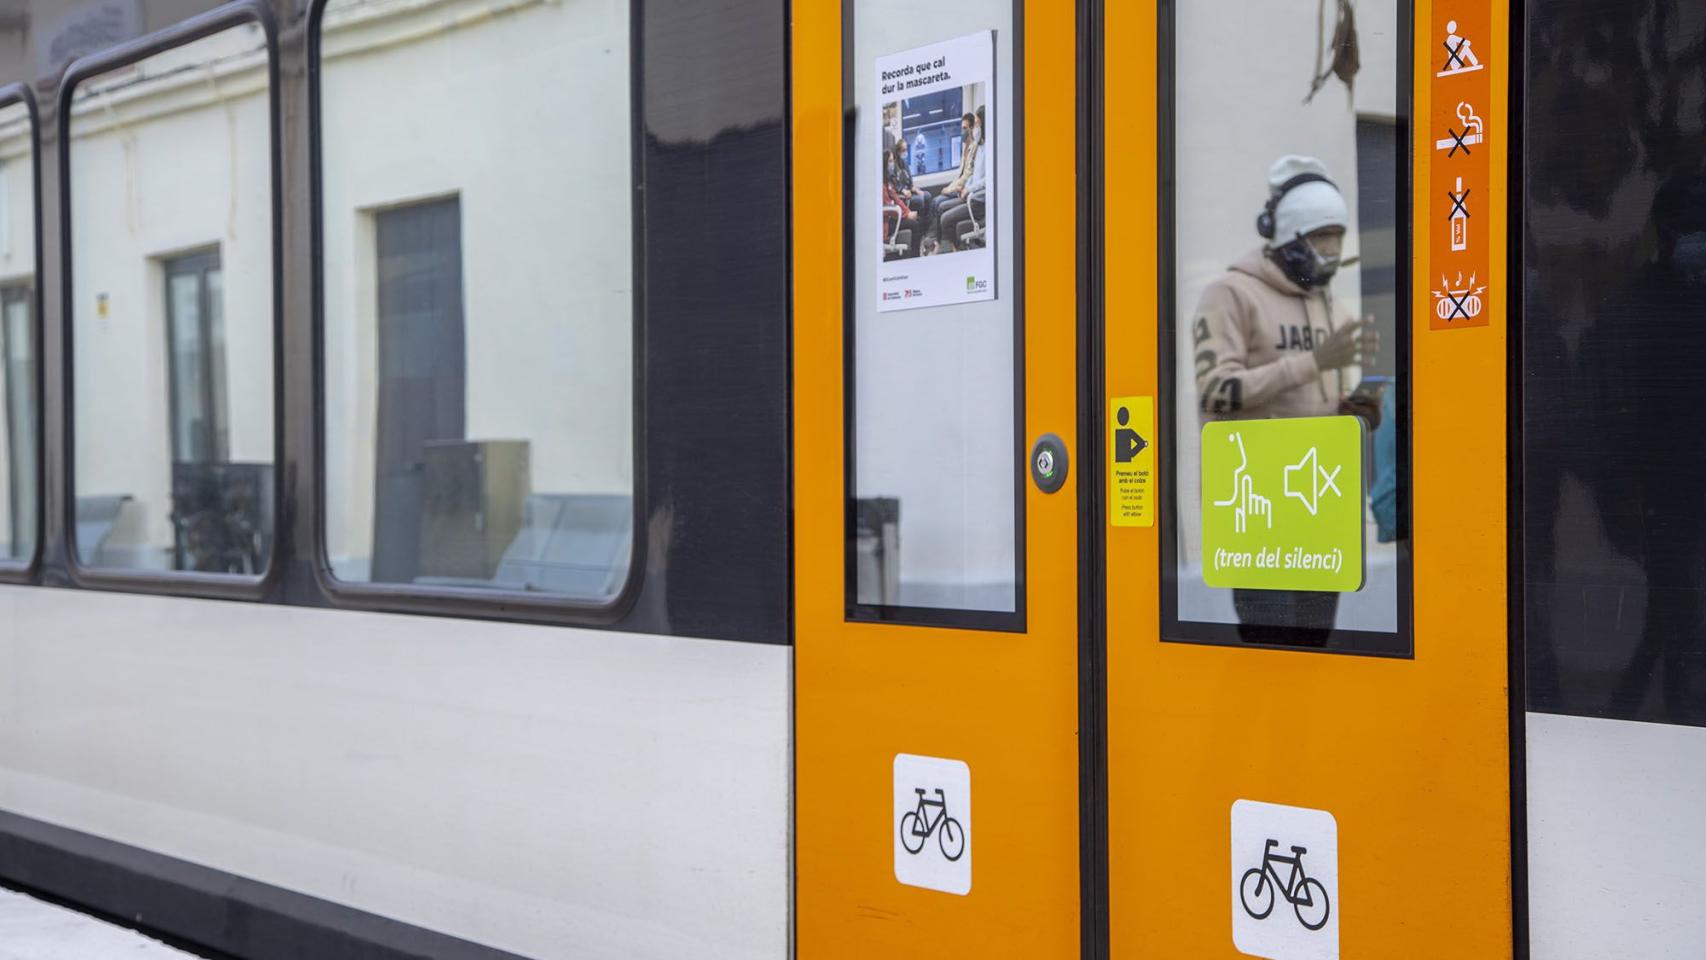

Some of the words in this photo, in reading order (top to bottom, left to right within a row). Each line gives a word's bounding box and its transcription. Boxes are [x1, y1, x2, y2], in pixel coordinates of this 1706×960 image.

[882, 65, 914, 81] Recorda
[915, 62, 931, 75] que
[933, 56, 946, 69] cal
[881, 84, 896, 95] dur
[897, 81, 905, 91] la
[906, 71, 951, 89] mascareta.
[975, 280, 987, 289] FGC
[1214, 547, 1253, 571] (tren
[1255, 547, 1281, 569] del
[1284, 547, 1343, 574] silenci)
